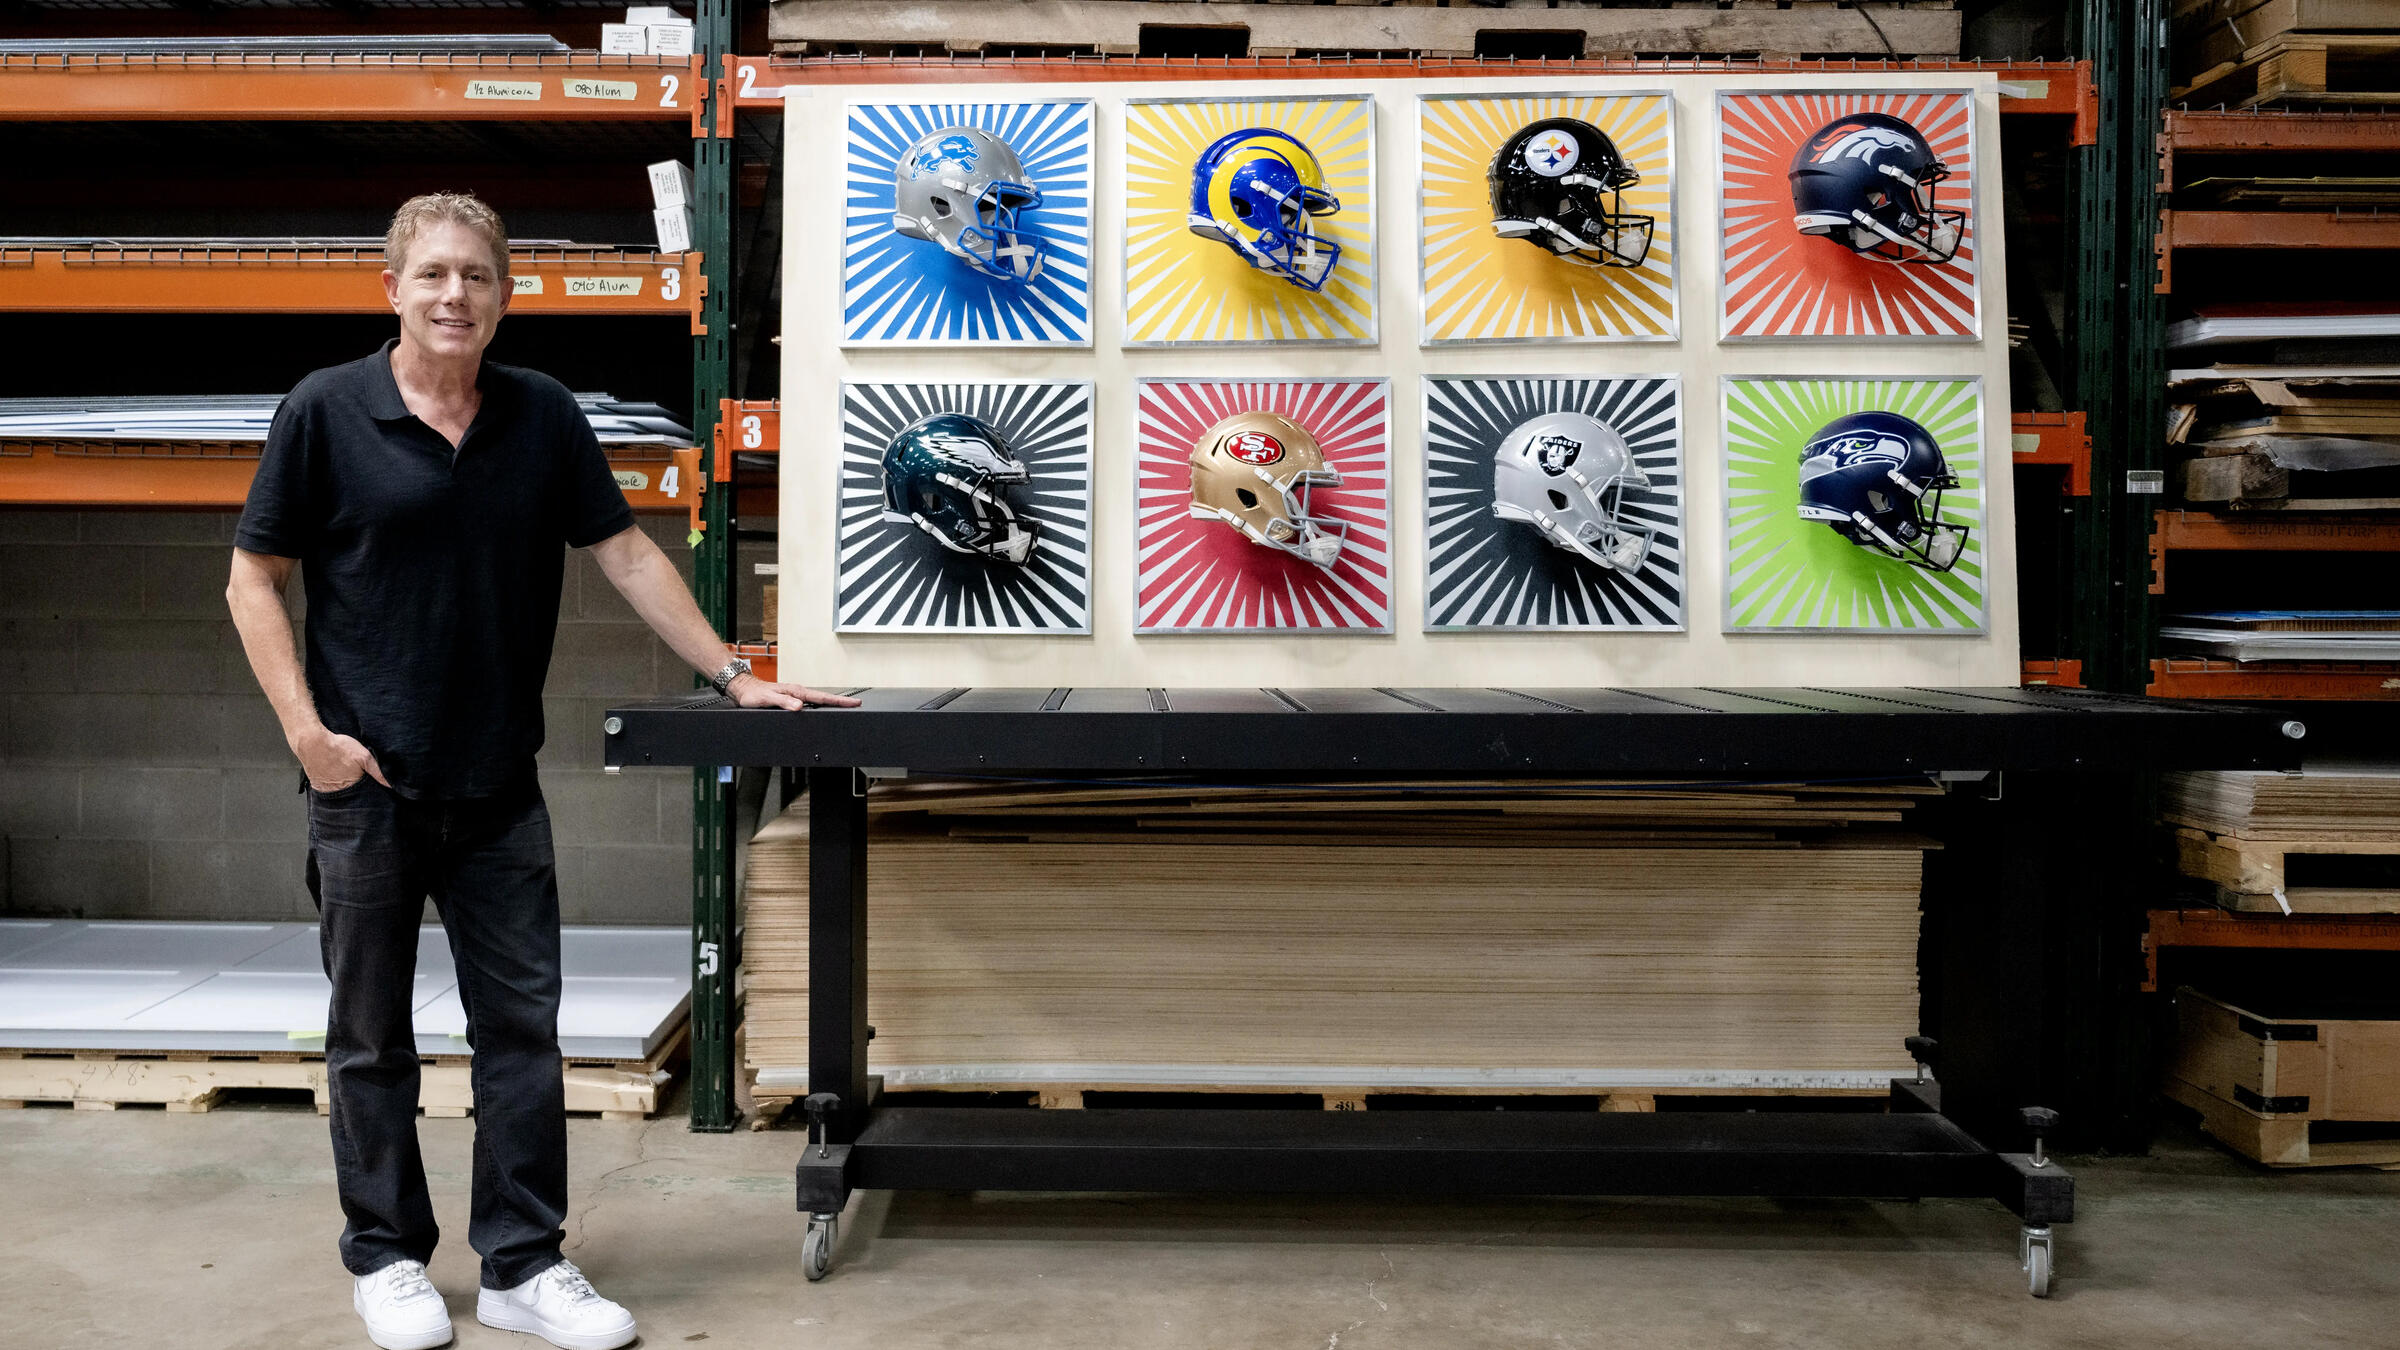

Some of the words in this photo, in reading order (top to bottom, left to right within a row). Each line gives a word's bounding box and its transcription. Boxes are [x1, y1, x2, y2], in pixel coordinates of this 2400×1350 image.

[594, 84, 621, 96] Alum
[660, 75, 679, 107] 2
[738, 65, 757, 98] 2
[599, 280, 630, 292] Alum
[661, 268, 680, 300] 3
[742, 415, 762, 448] 3
[1541, 437, 1578, 448] RAIDERS
[660, 466, 679, 498] 4
[699, 942, 718, 975] 5
[82, 1064, 96, 1082] 4
[128, 1062, 140, 1087] 8
